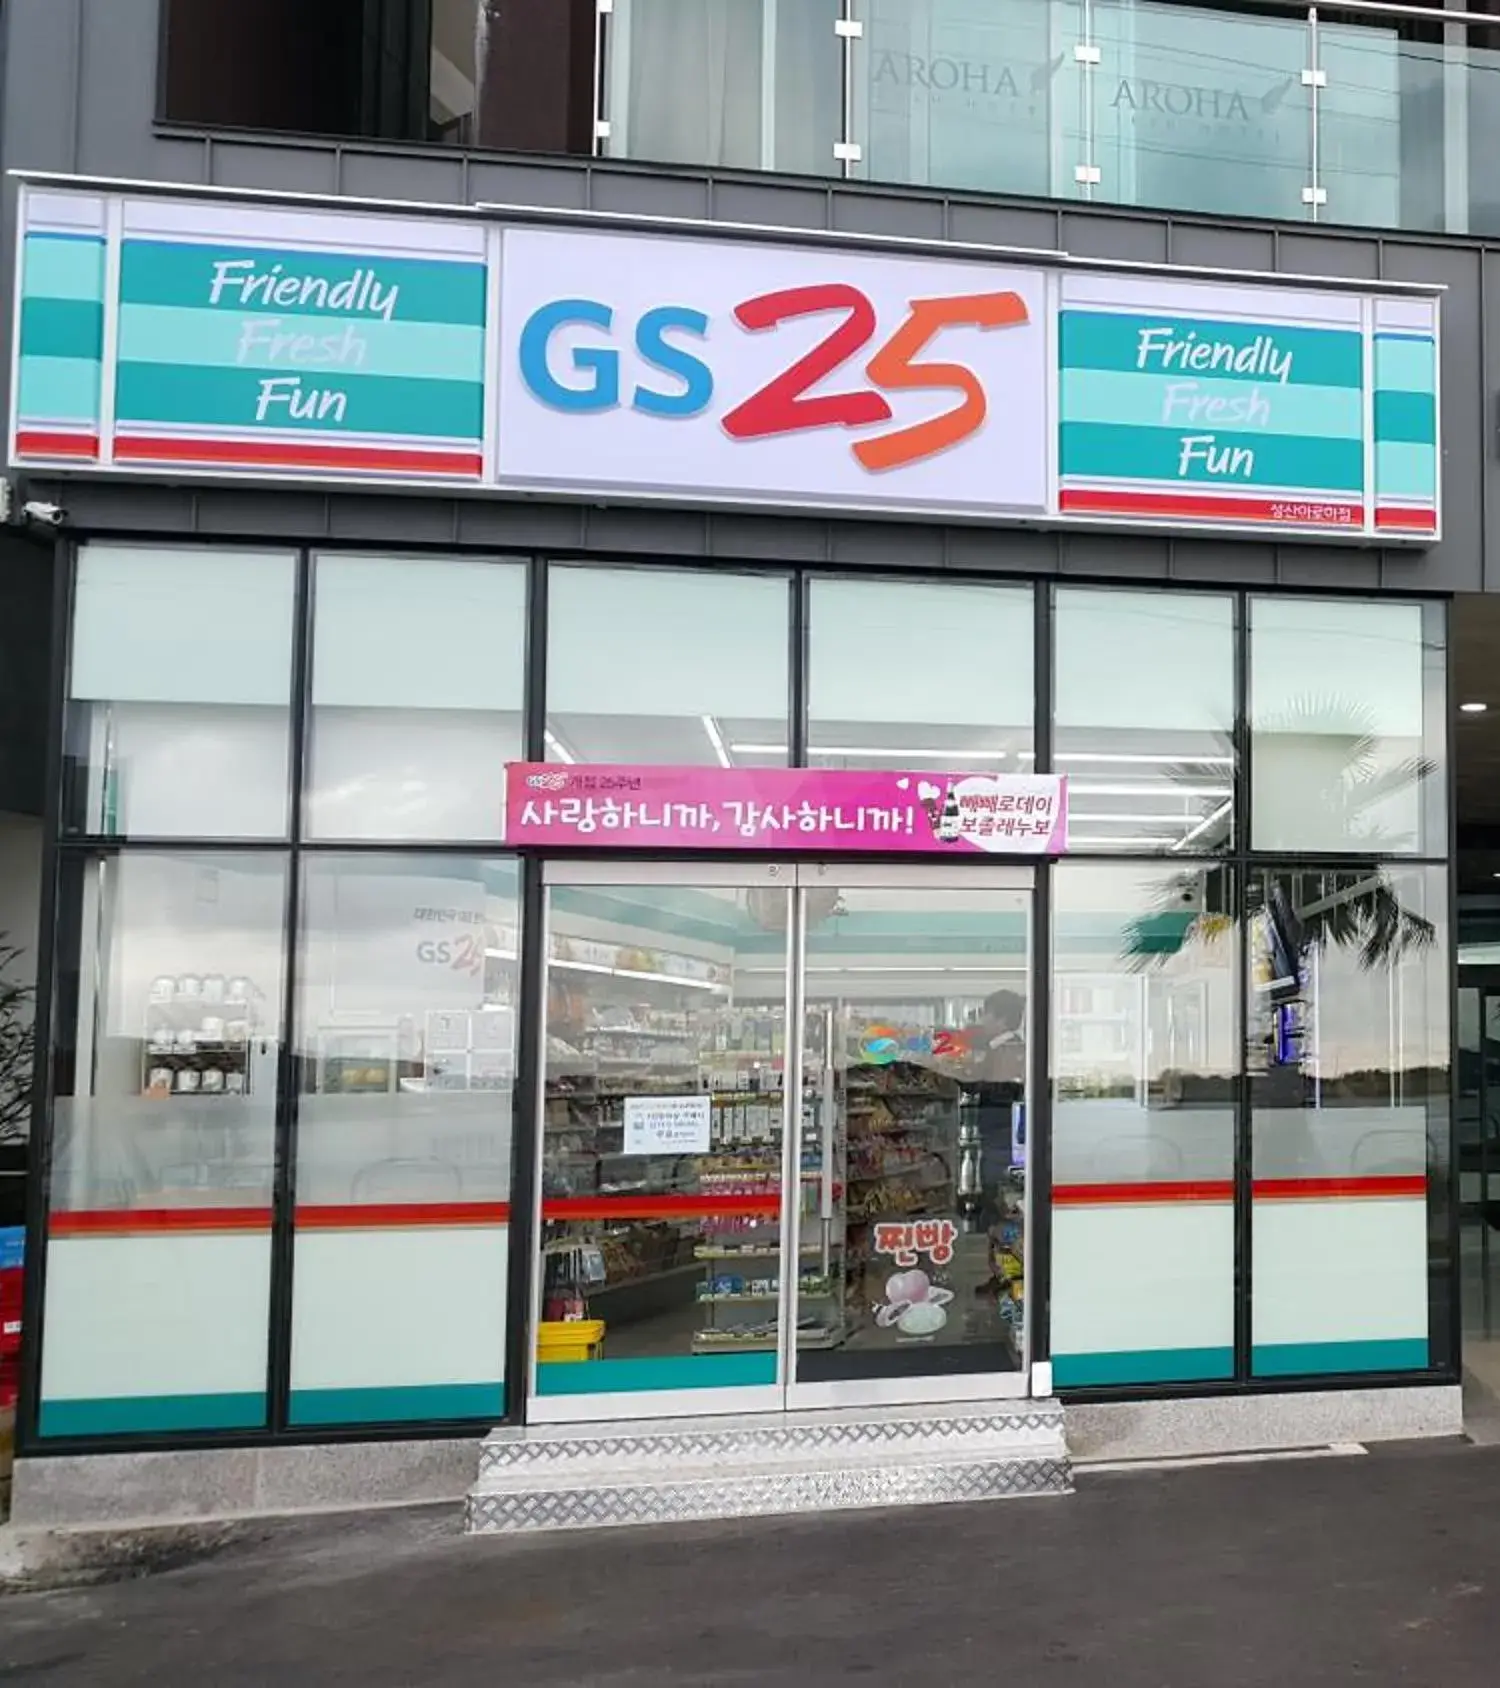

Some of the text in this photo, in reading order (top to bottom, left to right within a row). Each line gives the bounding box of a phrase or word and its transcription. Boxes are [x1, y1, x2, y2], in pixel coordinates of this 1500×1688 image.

[873, 51, 1020, 98] AROHA
[1112, 78, 1250, 121] AROHA
[208, 259, 400, 322] Friendly
[236, 318, 368, 369] Fresh
[1136, 327, 1293, 383] Friendly
[255, 376, 348, 421] Fun
[1161, 383, 1271, 427] Fresh
[1178, 435, 1255, 478] Fun
[520, 797, 914, 837] 사랑하니까, 감사하니까!
[875, 1219, 958, 1266] 찐빵
